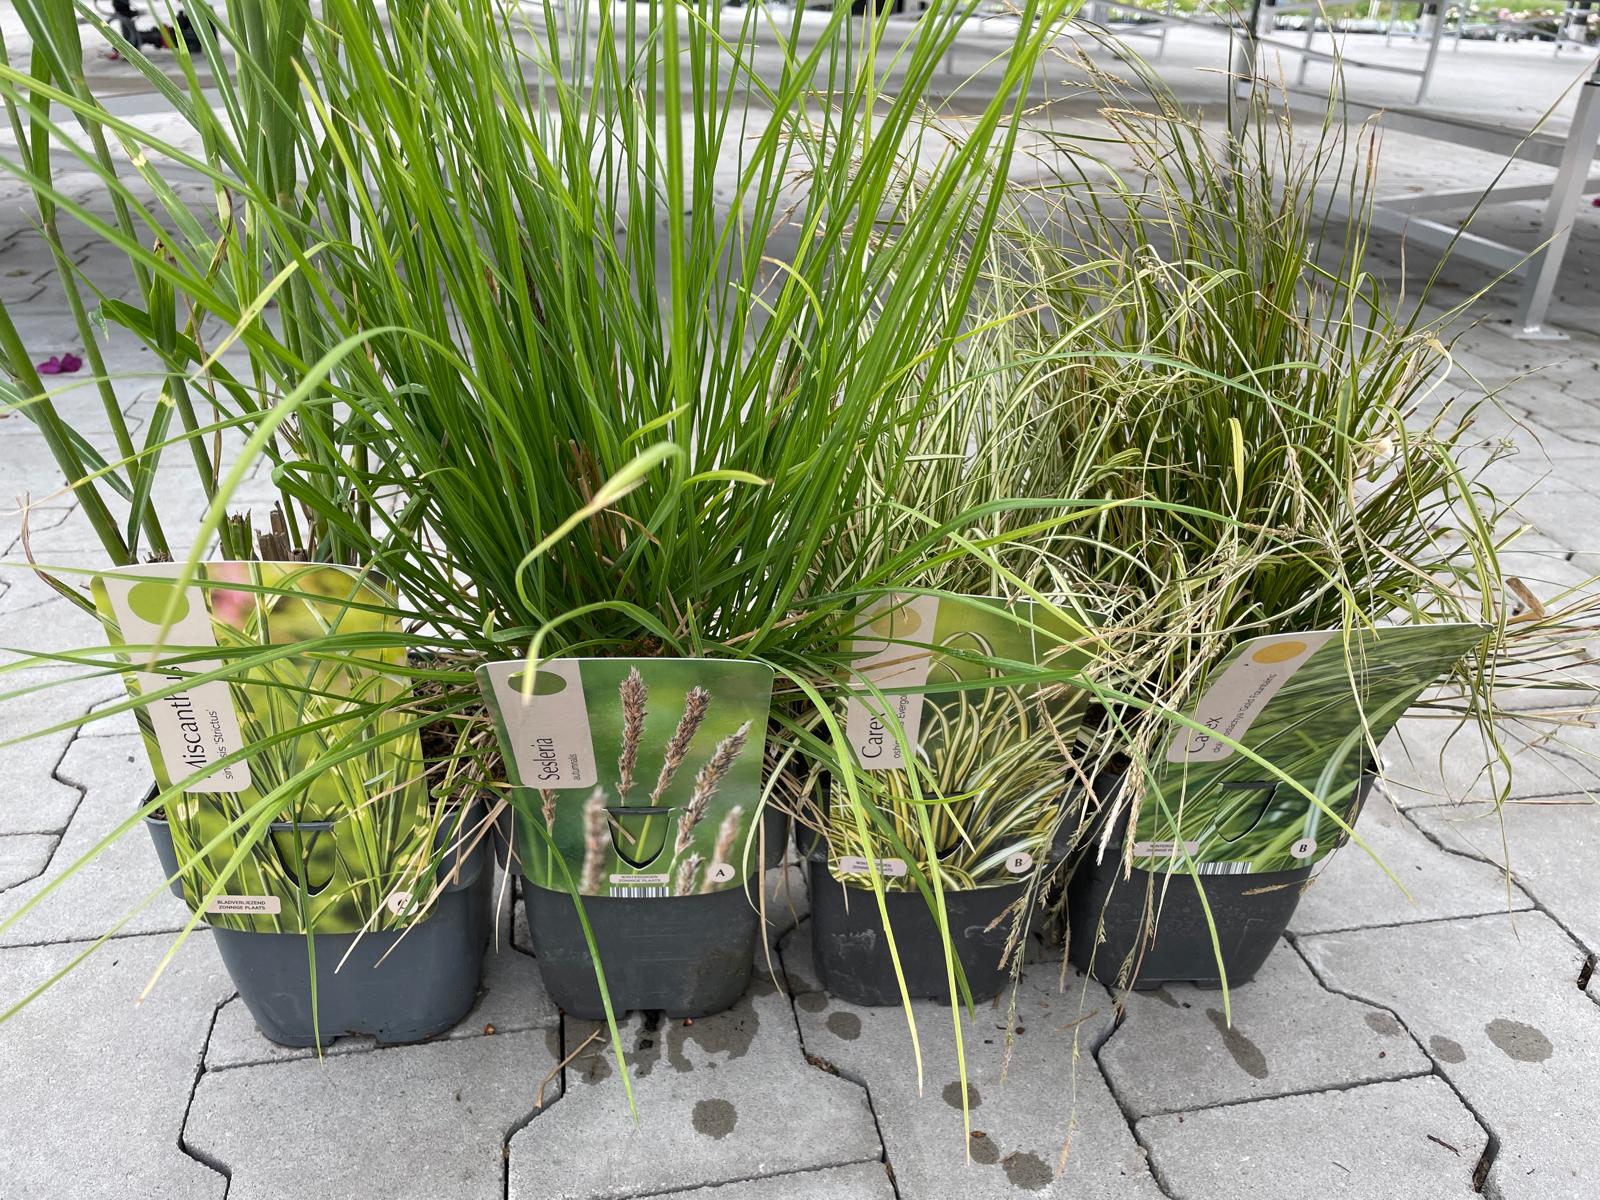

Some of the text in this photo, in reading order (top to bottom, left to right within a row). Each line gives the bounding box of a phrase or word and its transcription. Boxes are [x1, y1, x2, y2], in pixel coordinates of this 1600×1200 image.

[530, 738, 560, 780] Sesleria
[1299, 843, 1308, 853] B
[1015, 858, 1023, 867] B
[715, 868, 726, 877] A
